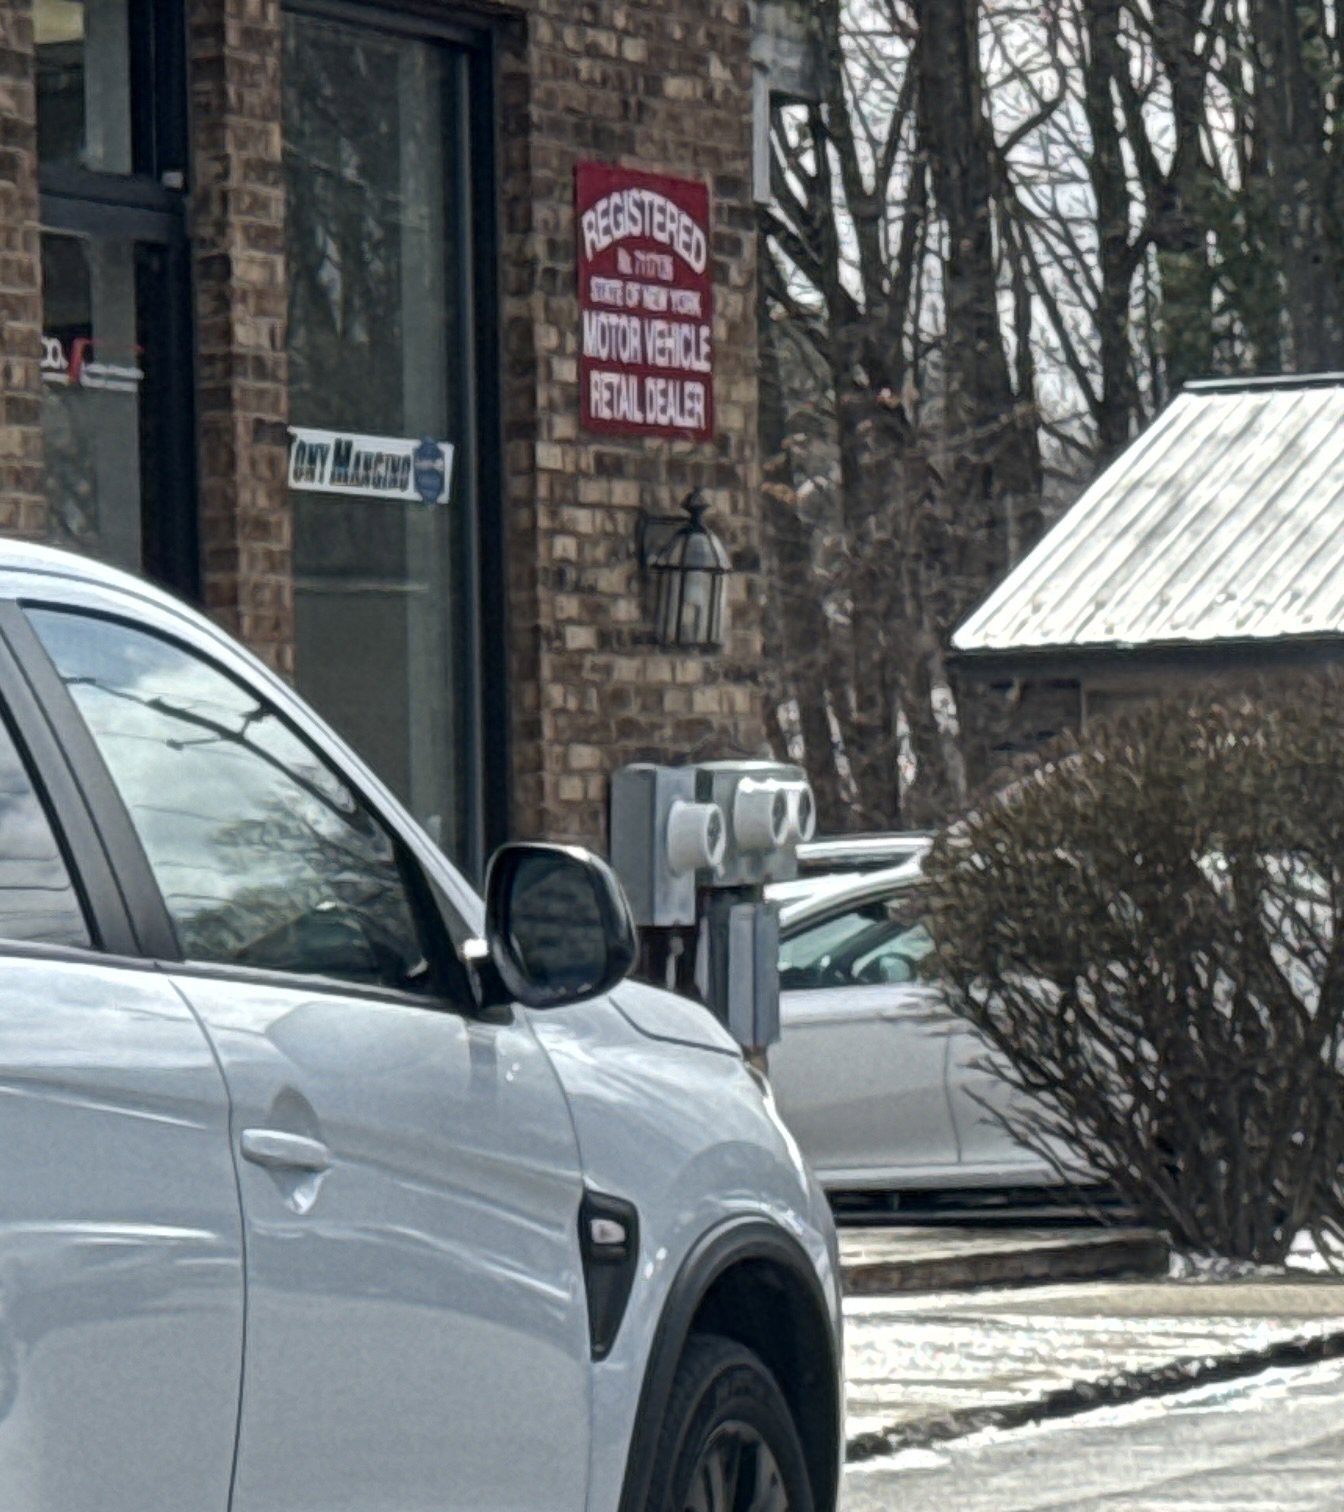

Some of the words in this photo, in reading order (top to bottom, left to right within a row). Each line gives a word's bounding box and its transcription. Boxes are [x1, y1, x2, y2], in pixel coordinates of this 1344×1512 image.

[581, 187, 707, 275] REGISTERED
[582, 309, 642, 364] MOTOR
[644, 318, 712, 373] VEHICLE
[589, 369, 644, 424] RETAIL
[645, 375, 706, 431] DEALER
